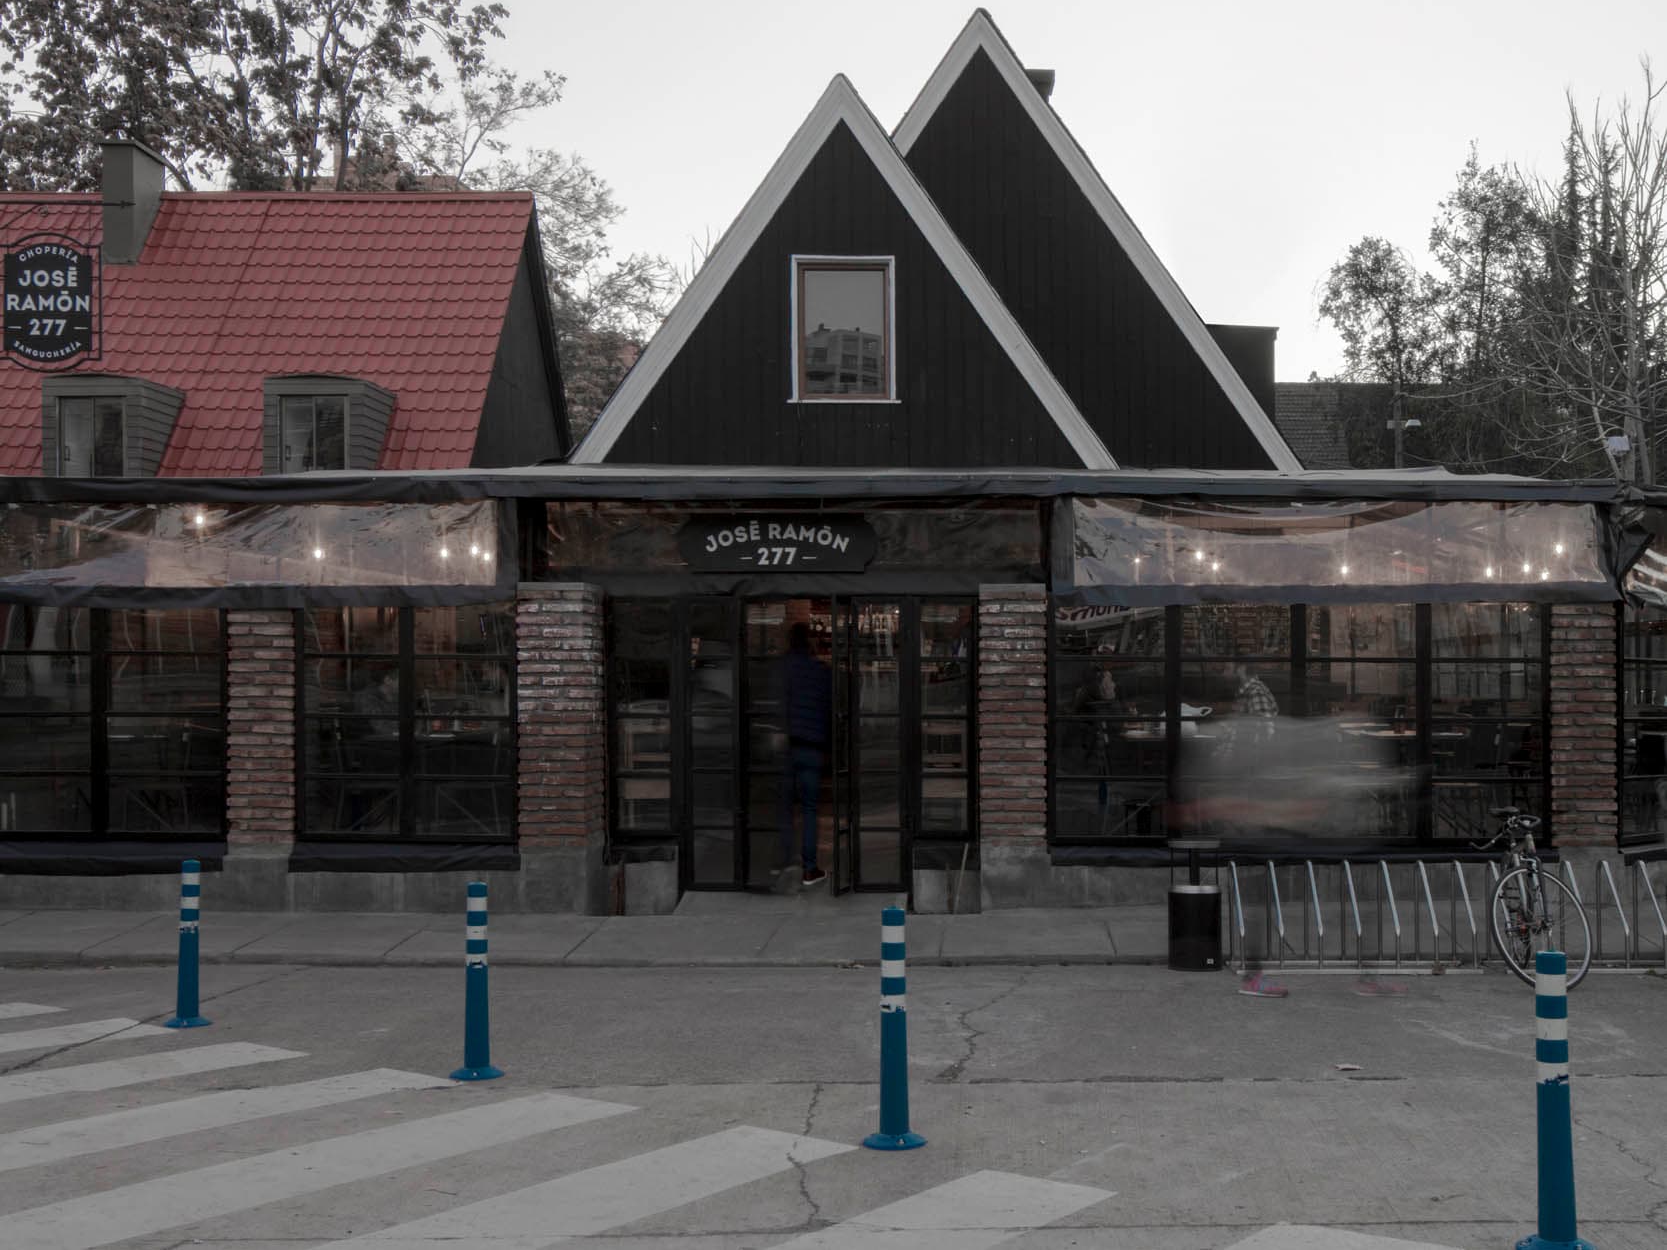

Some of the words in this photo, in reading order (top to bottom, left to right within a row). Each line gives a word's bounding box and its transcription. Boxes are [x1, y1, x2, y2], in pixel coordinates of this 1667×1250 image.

[19, 246, 78, 263] CHOPERÍA
[18, 266, 78, 287] JOSÉ
[29, 318, 67, 336] 277
[13, 340, 82, 358] SANGUCHERÍA
[705, 520, 761, 552] JOSÉ
[757, 547, 797, 566] 277
